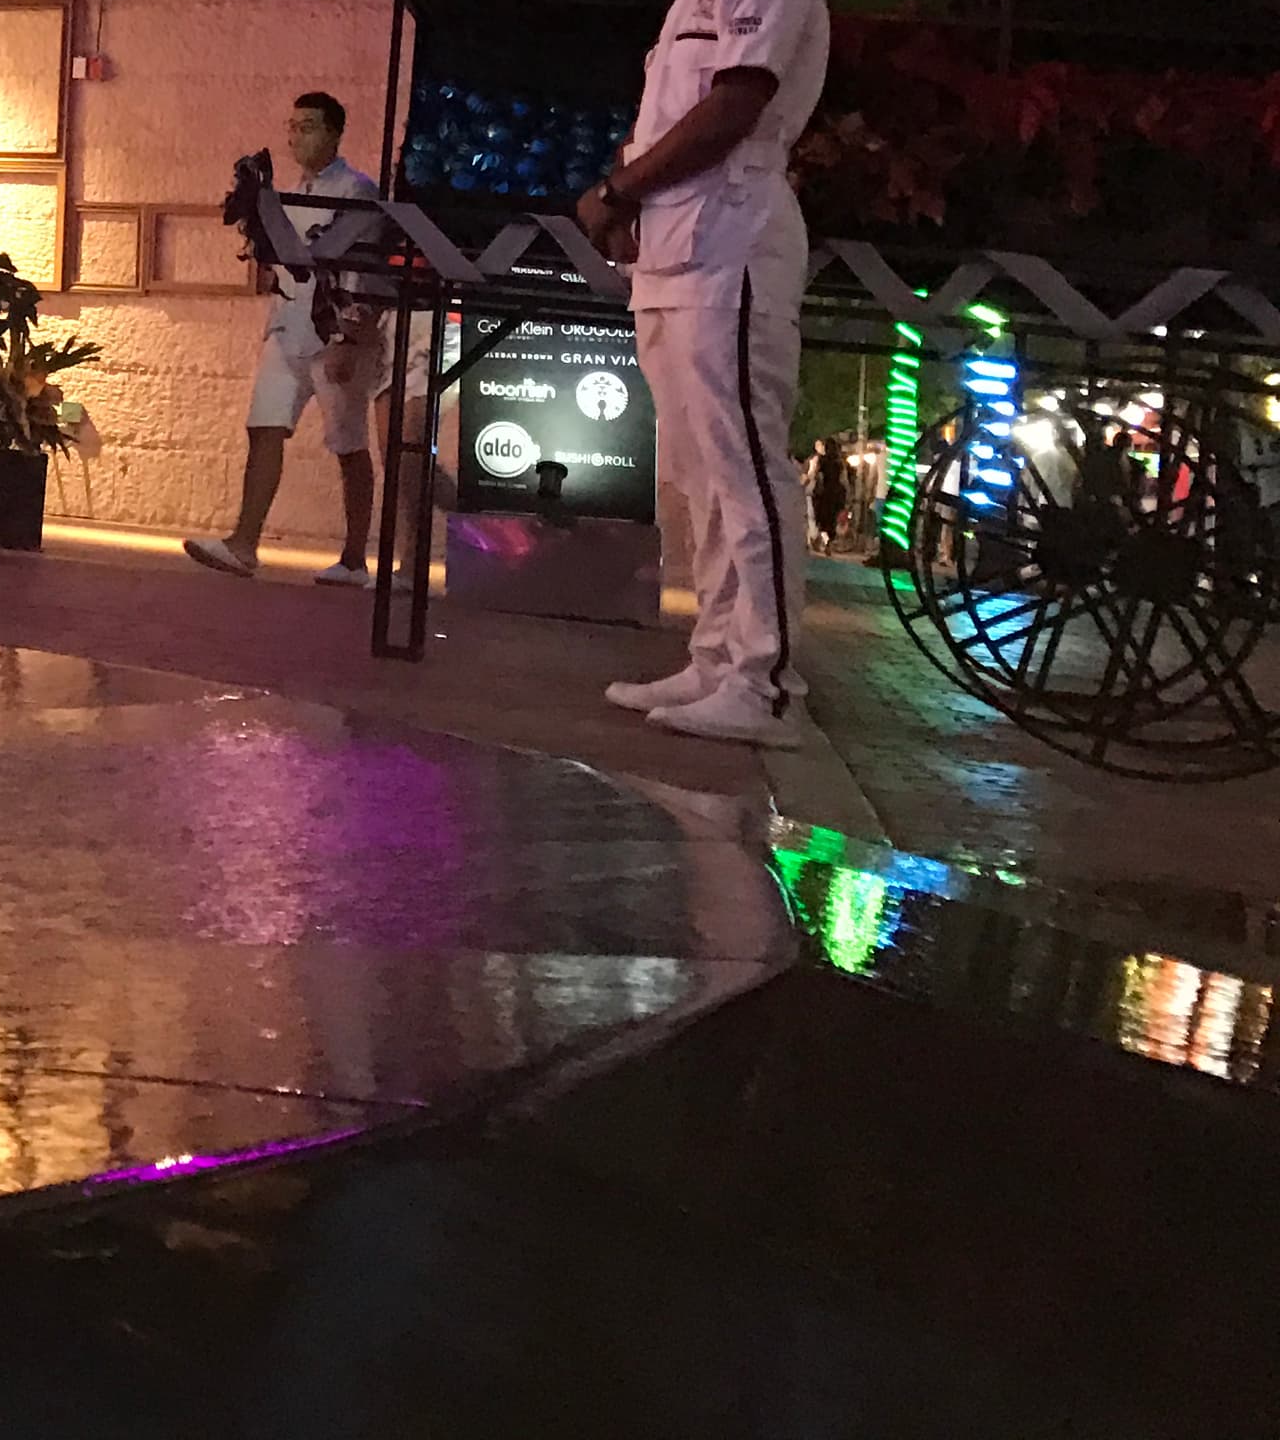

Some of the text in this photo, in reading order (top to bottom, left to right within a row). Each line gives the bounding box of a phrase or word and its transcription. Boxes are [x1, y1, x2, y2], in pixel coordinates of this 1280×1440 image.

[521, 321, 554, 336] Klein
[560, 352, 639, 367] GRAN VIA
[483, 437, 523, 459] aldo
[604, 455, 636, 467] ROLL
